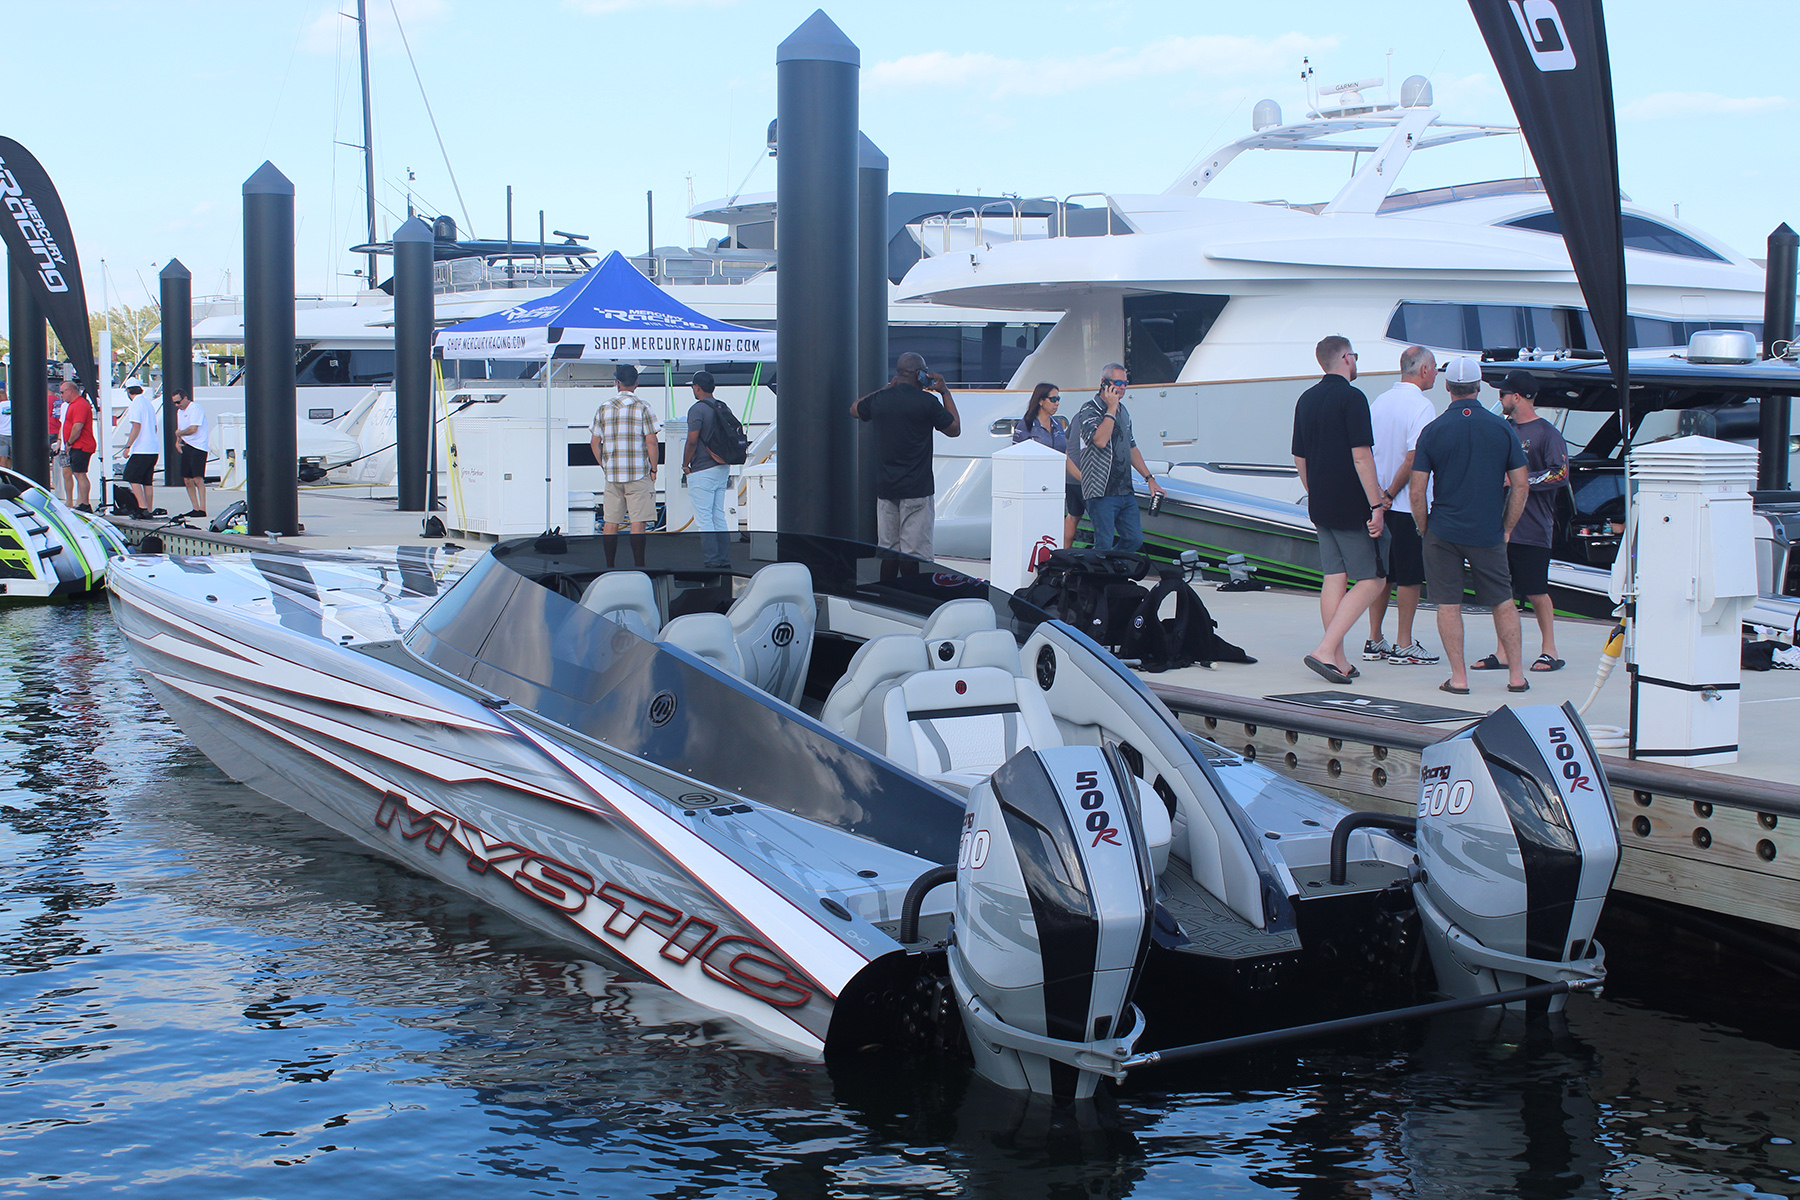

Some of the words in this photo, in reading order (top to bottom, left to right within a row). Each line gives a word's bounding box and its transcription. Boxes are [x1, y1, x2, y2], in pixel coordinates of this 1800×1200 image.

[1335, 82, 1359, 91] GARMIN
[21, 198, 67, 265] MERCURY
[594, 336, 760, 352] SHOP.MERCURYRACING.COM
[1418, 779, 1474, 818] 500
[374, 790, 811, 1007] MYSTIC
